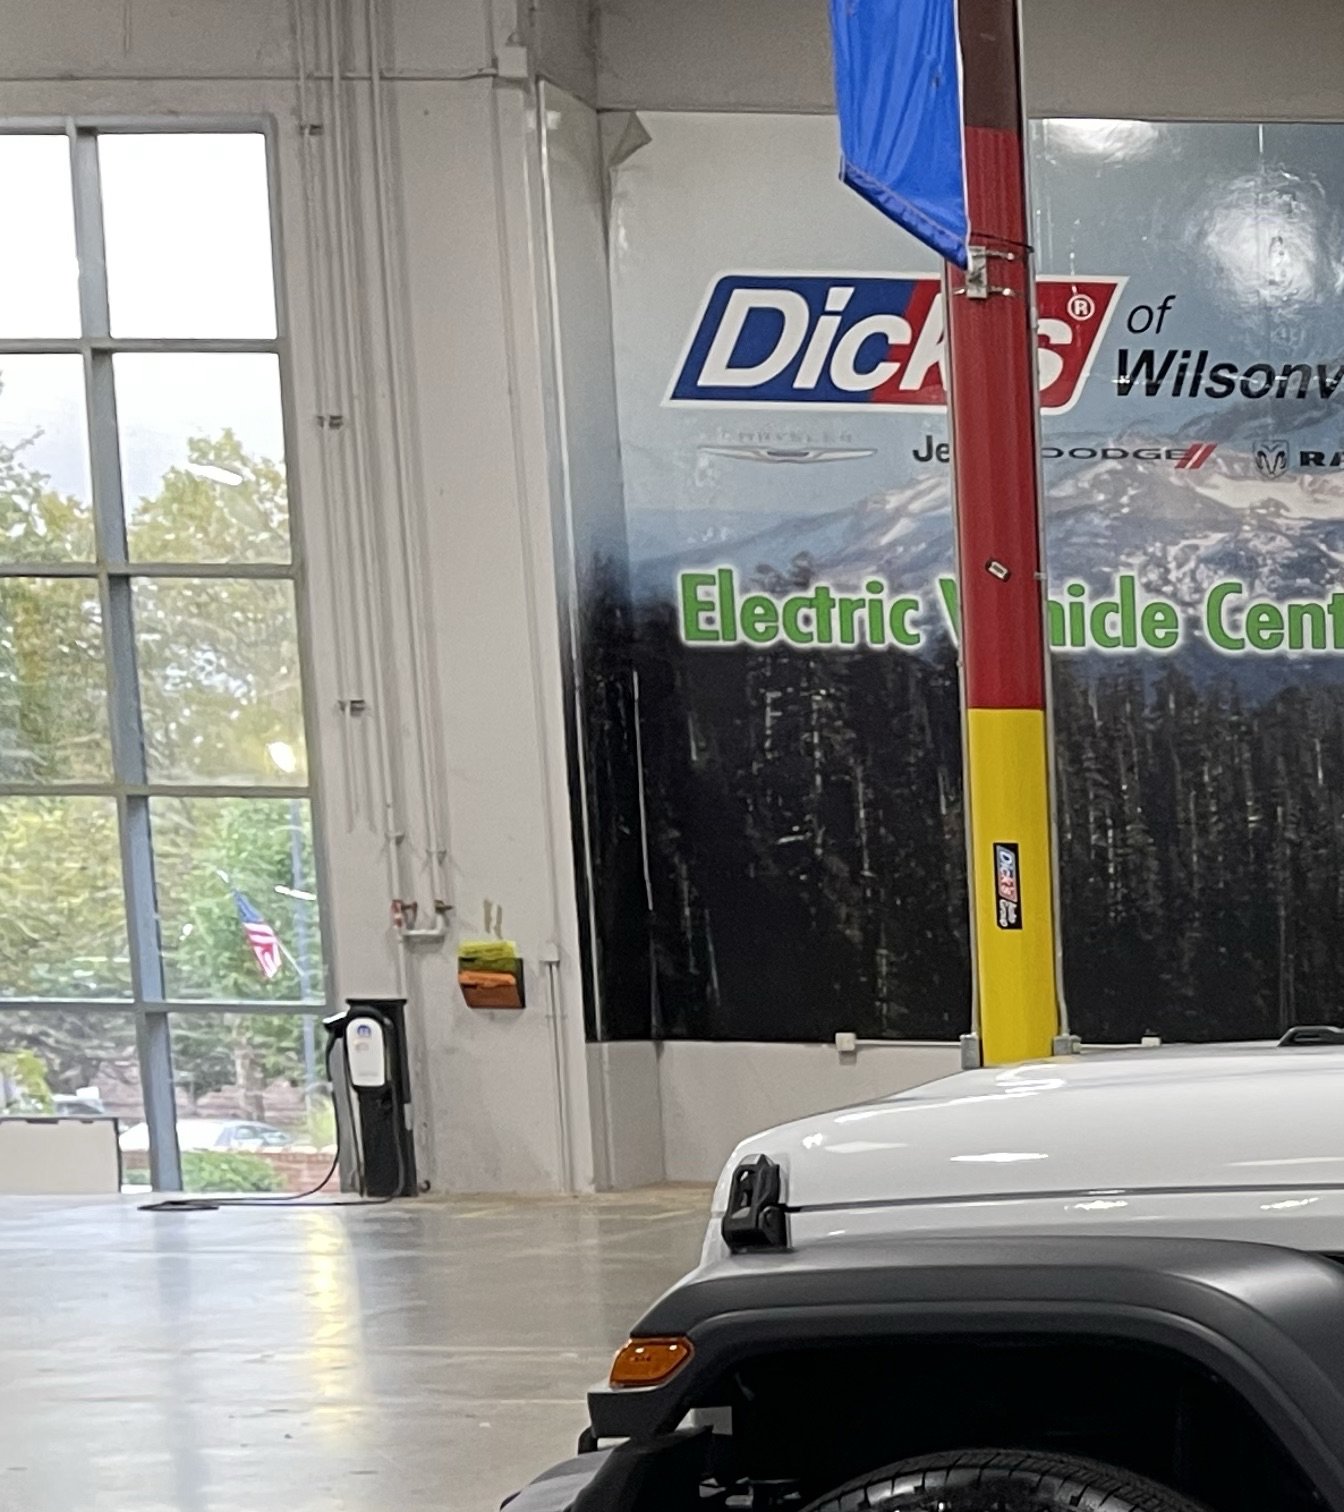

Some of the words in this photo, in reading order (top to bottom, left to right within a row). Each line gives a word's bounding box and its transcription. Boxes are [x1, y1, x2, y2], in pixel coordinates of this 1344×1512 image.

[697, 287, 1074, 393] Dicks
[1127, 295, 1176, 334] of
[912, 435, 951, 463] Je
[1041, 446, 1192, 460] DODGE
[680, 568, 921, 646] Electric
[938, 575, 1179, 649] icle
